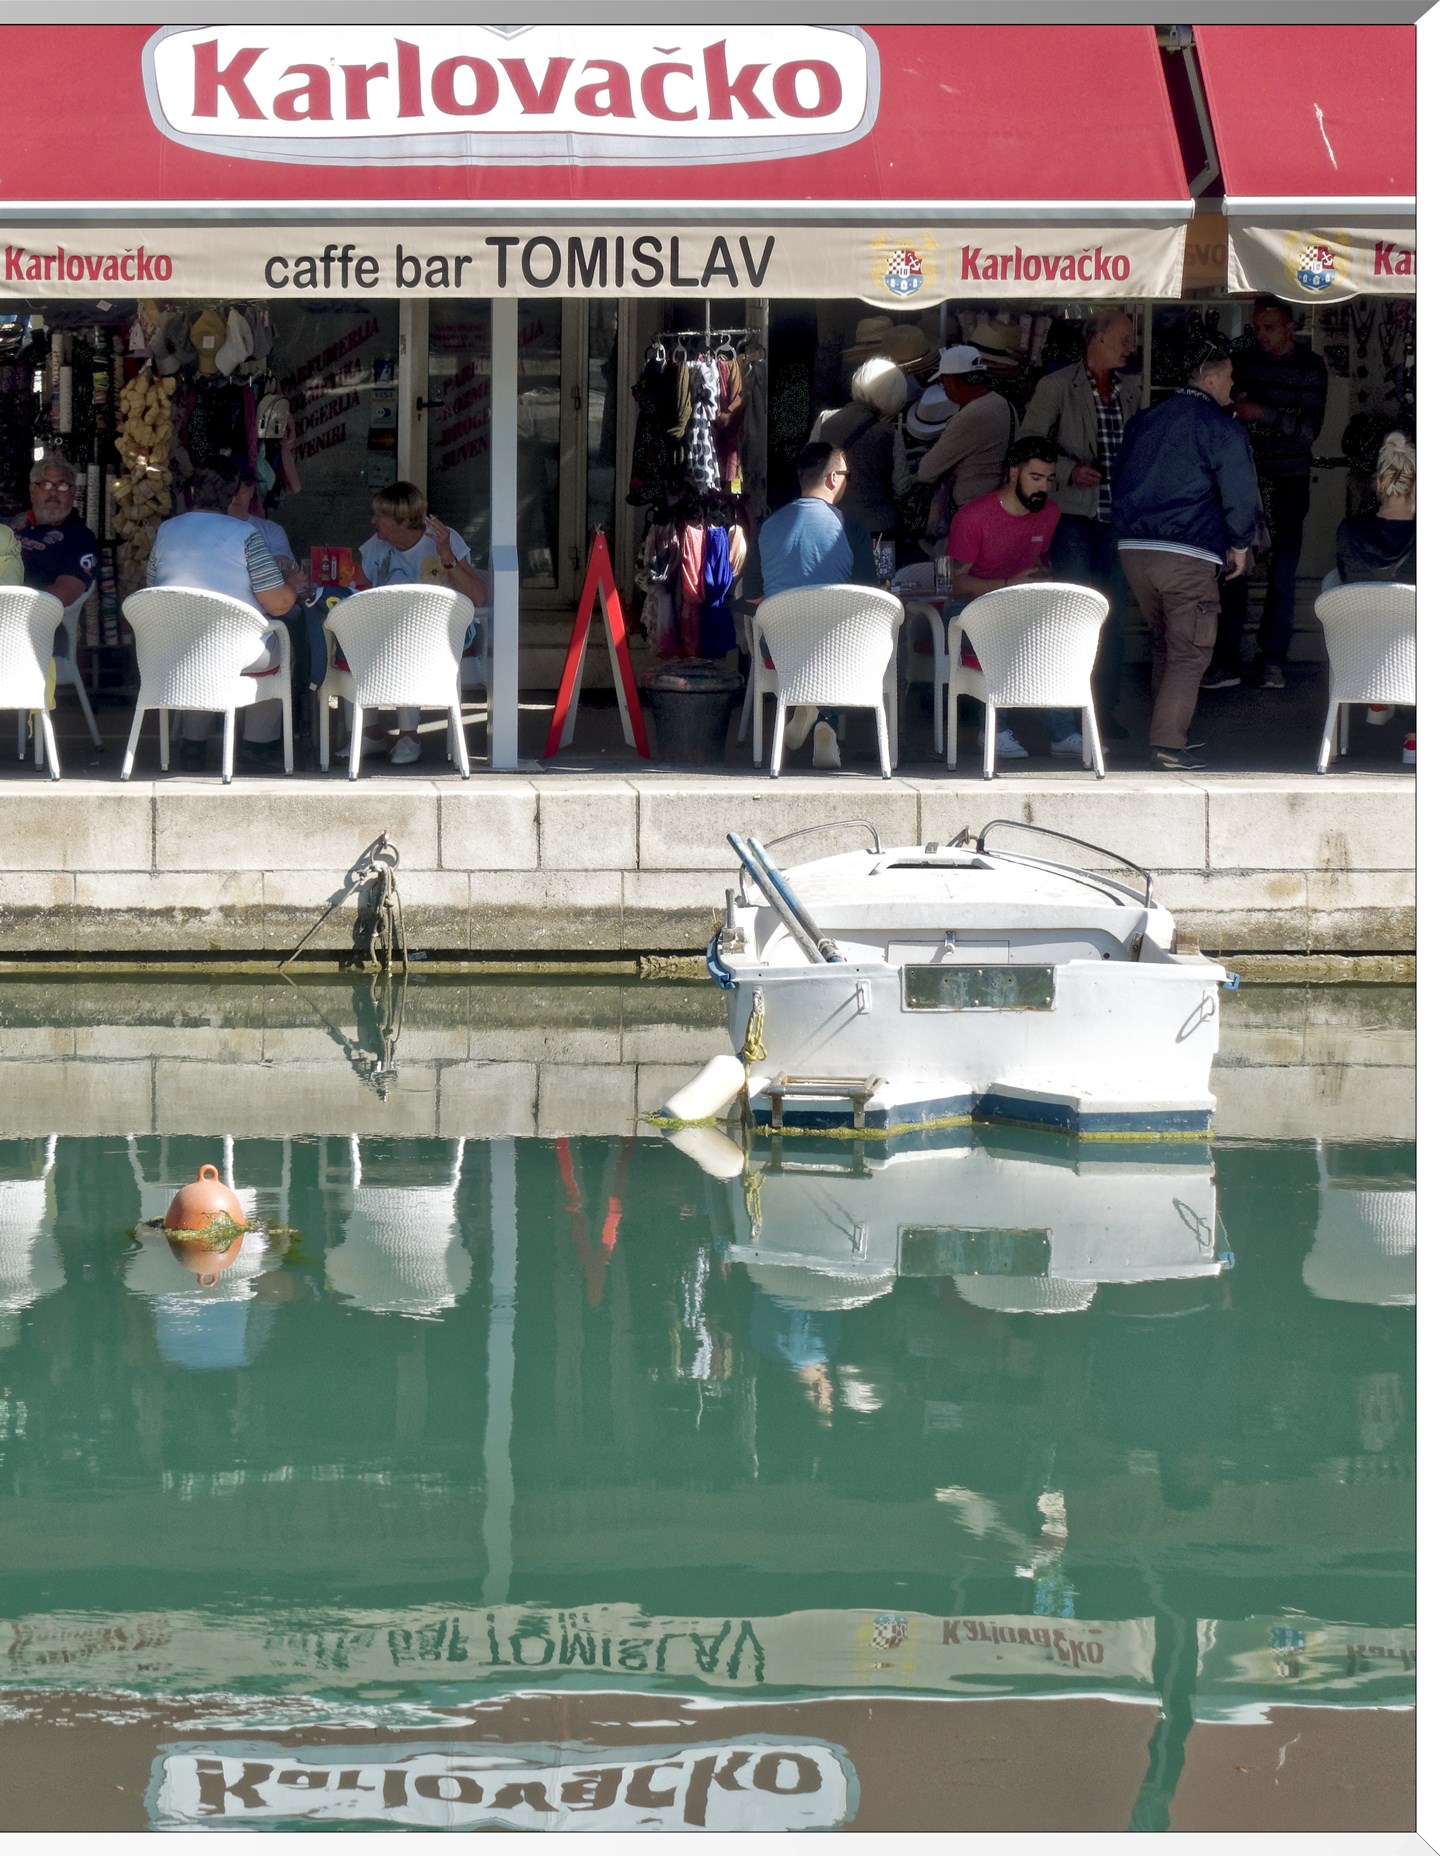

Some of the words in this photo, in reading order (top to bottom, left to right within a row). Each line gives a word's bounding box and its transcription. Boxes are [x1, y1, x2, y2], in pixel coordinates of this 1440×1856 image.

[191, 37, 843, 122] Karlovačko
[4, 245, 173, 281] Karlovačko
[264, 244, 380, 289] caffe
[396, 243, 472, 289] bar
[485, 235, 775, 289] TOMISLAV
[961, 245, 1130, 281] Karlovačko
[288, 391, 360, 438] ROGERIJA
